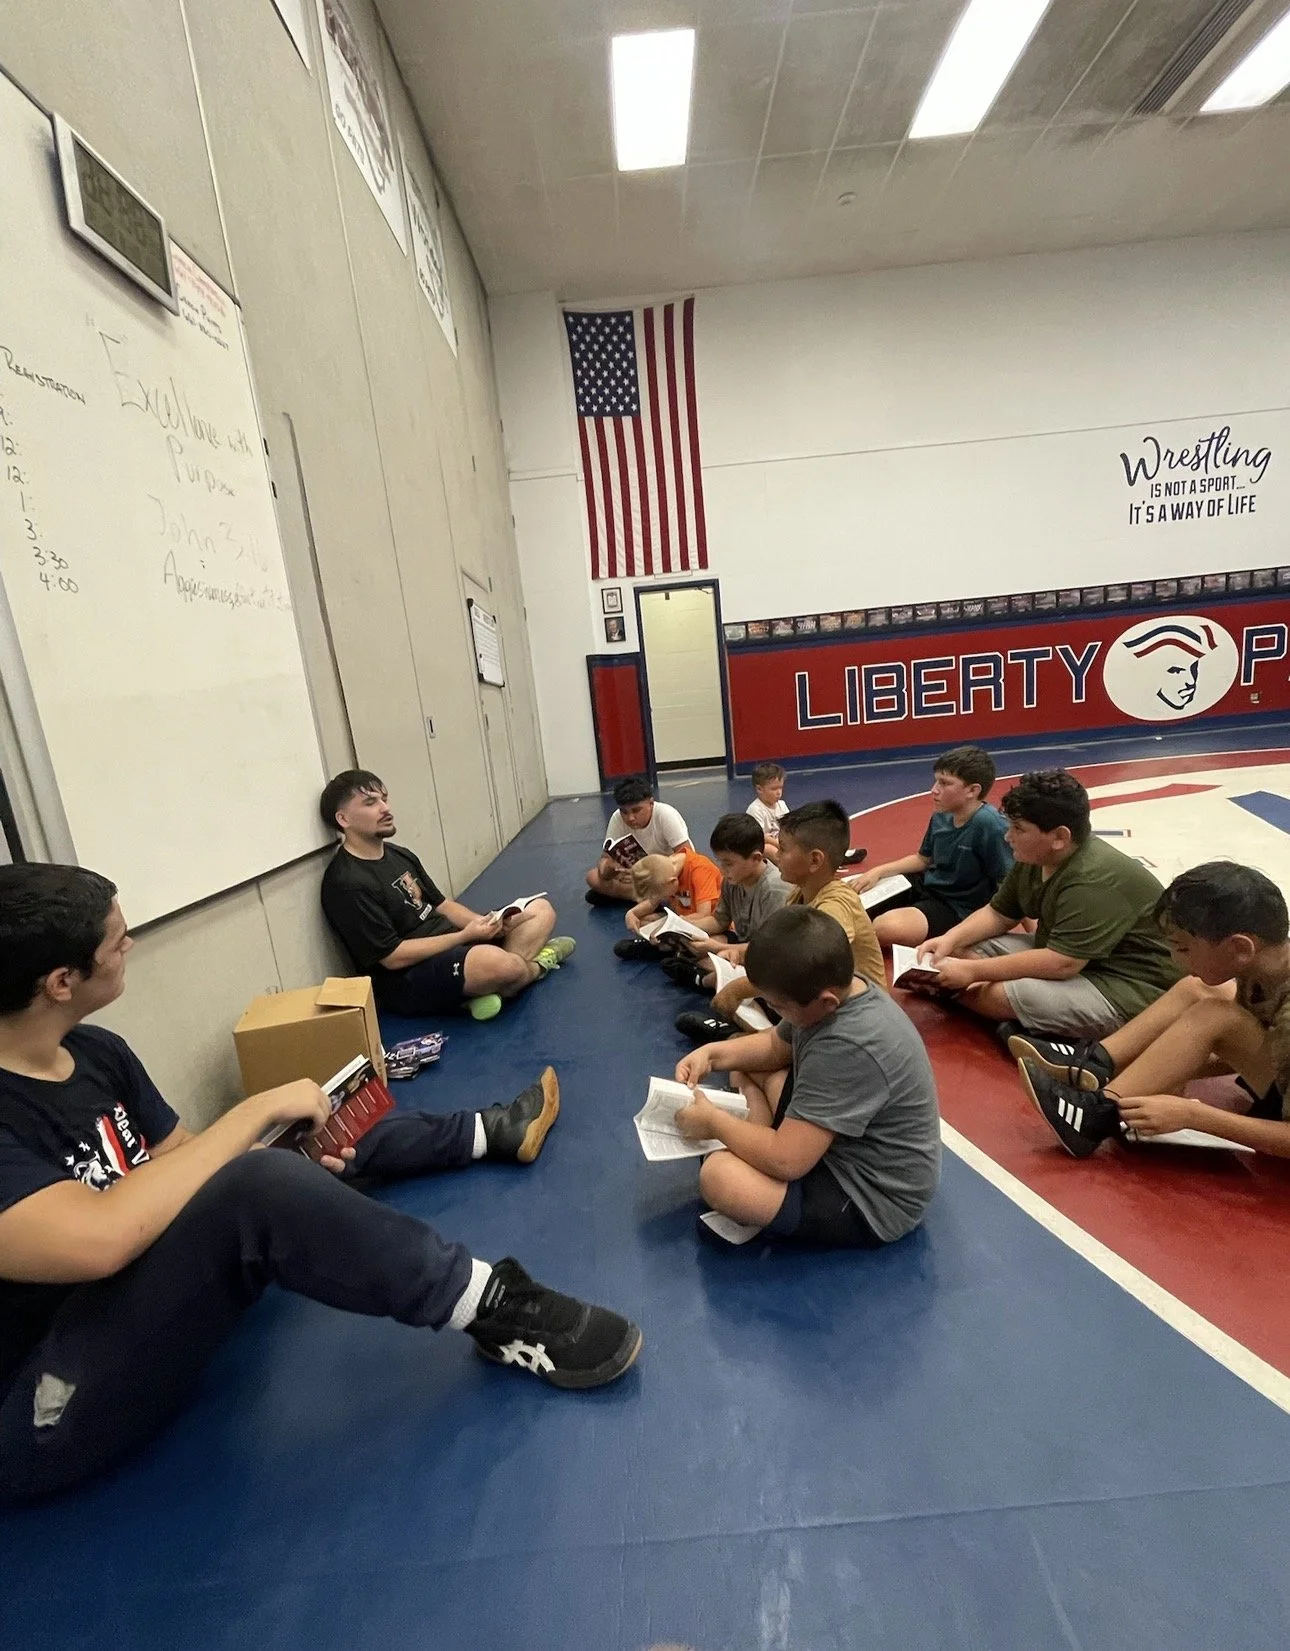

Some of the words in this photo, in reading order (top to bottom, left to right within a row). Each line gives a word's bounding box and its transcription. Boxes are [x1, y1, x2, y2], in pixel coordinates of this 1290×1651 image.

[1119, 426, 1272, 487] Wrestling
[7, 465, 30, 484] 12:
[1150, 483, 1162, 498] IS
[1165, 480, 1186, 496] NOT
[1189, 479, 1197, 495] A
[1129, 500, 1155, 525] IT'S
[1158, 504, 1167, 522] A
[1171, 500, 1204, 521] WAY
[1207, 498, 1225, 517] OF
[1228, 494, 1257, 515] LIFE
[24, 518, 43, 541] 3:
[147, 493, 217, 554] John
[33, 546, 69, 570] 3:30
[39, 571, 79, 593] 4:00
[796, 641, 1103, 731] LIBERTY
